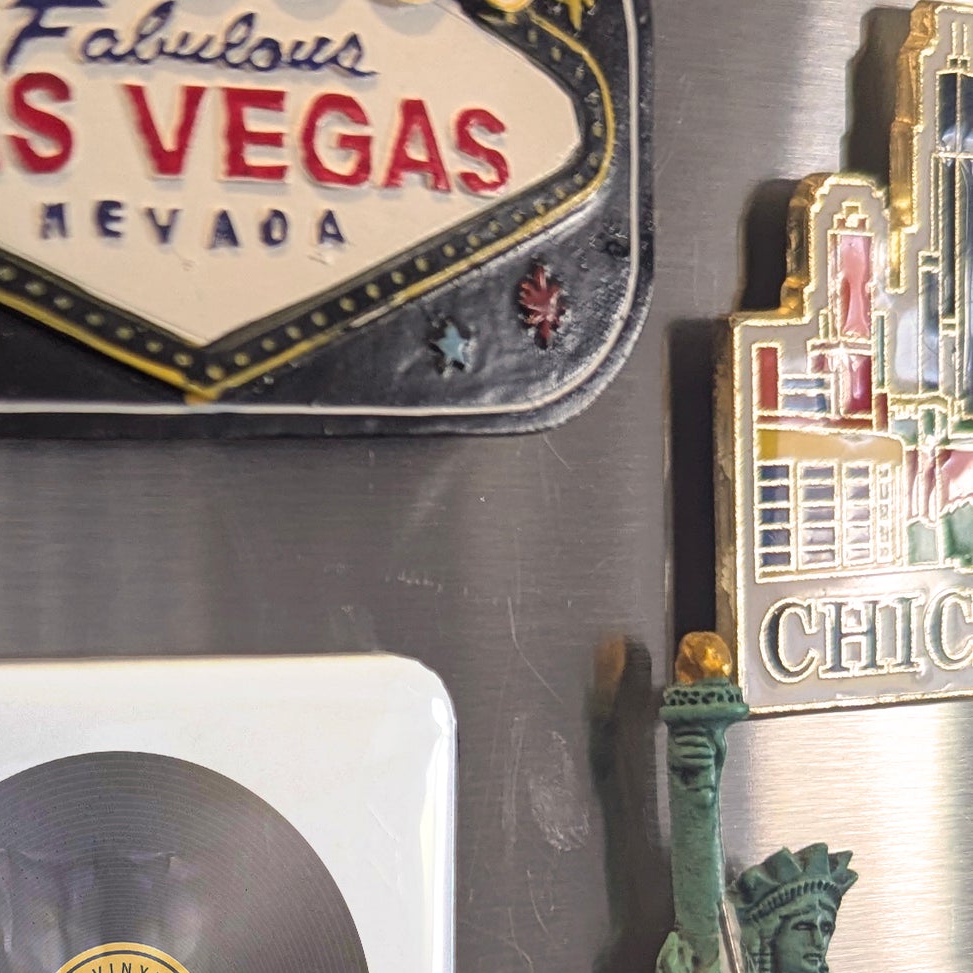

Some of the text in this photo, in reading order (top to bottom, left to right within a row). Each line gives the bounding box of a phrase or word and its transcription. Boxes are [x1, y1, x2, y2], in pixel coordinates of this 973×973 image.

[2, 0, 378, 78] Fabulous
[124, 83, 510, 195] VEGAS
[40, 199, 346, 249] NEVADA
